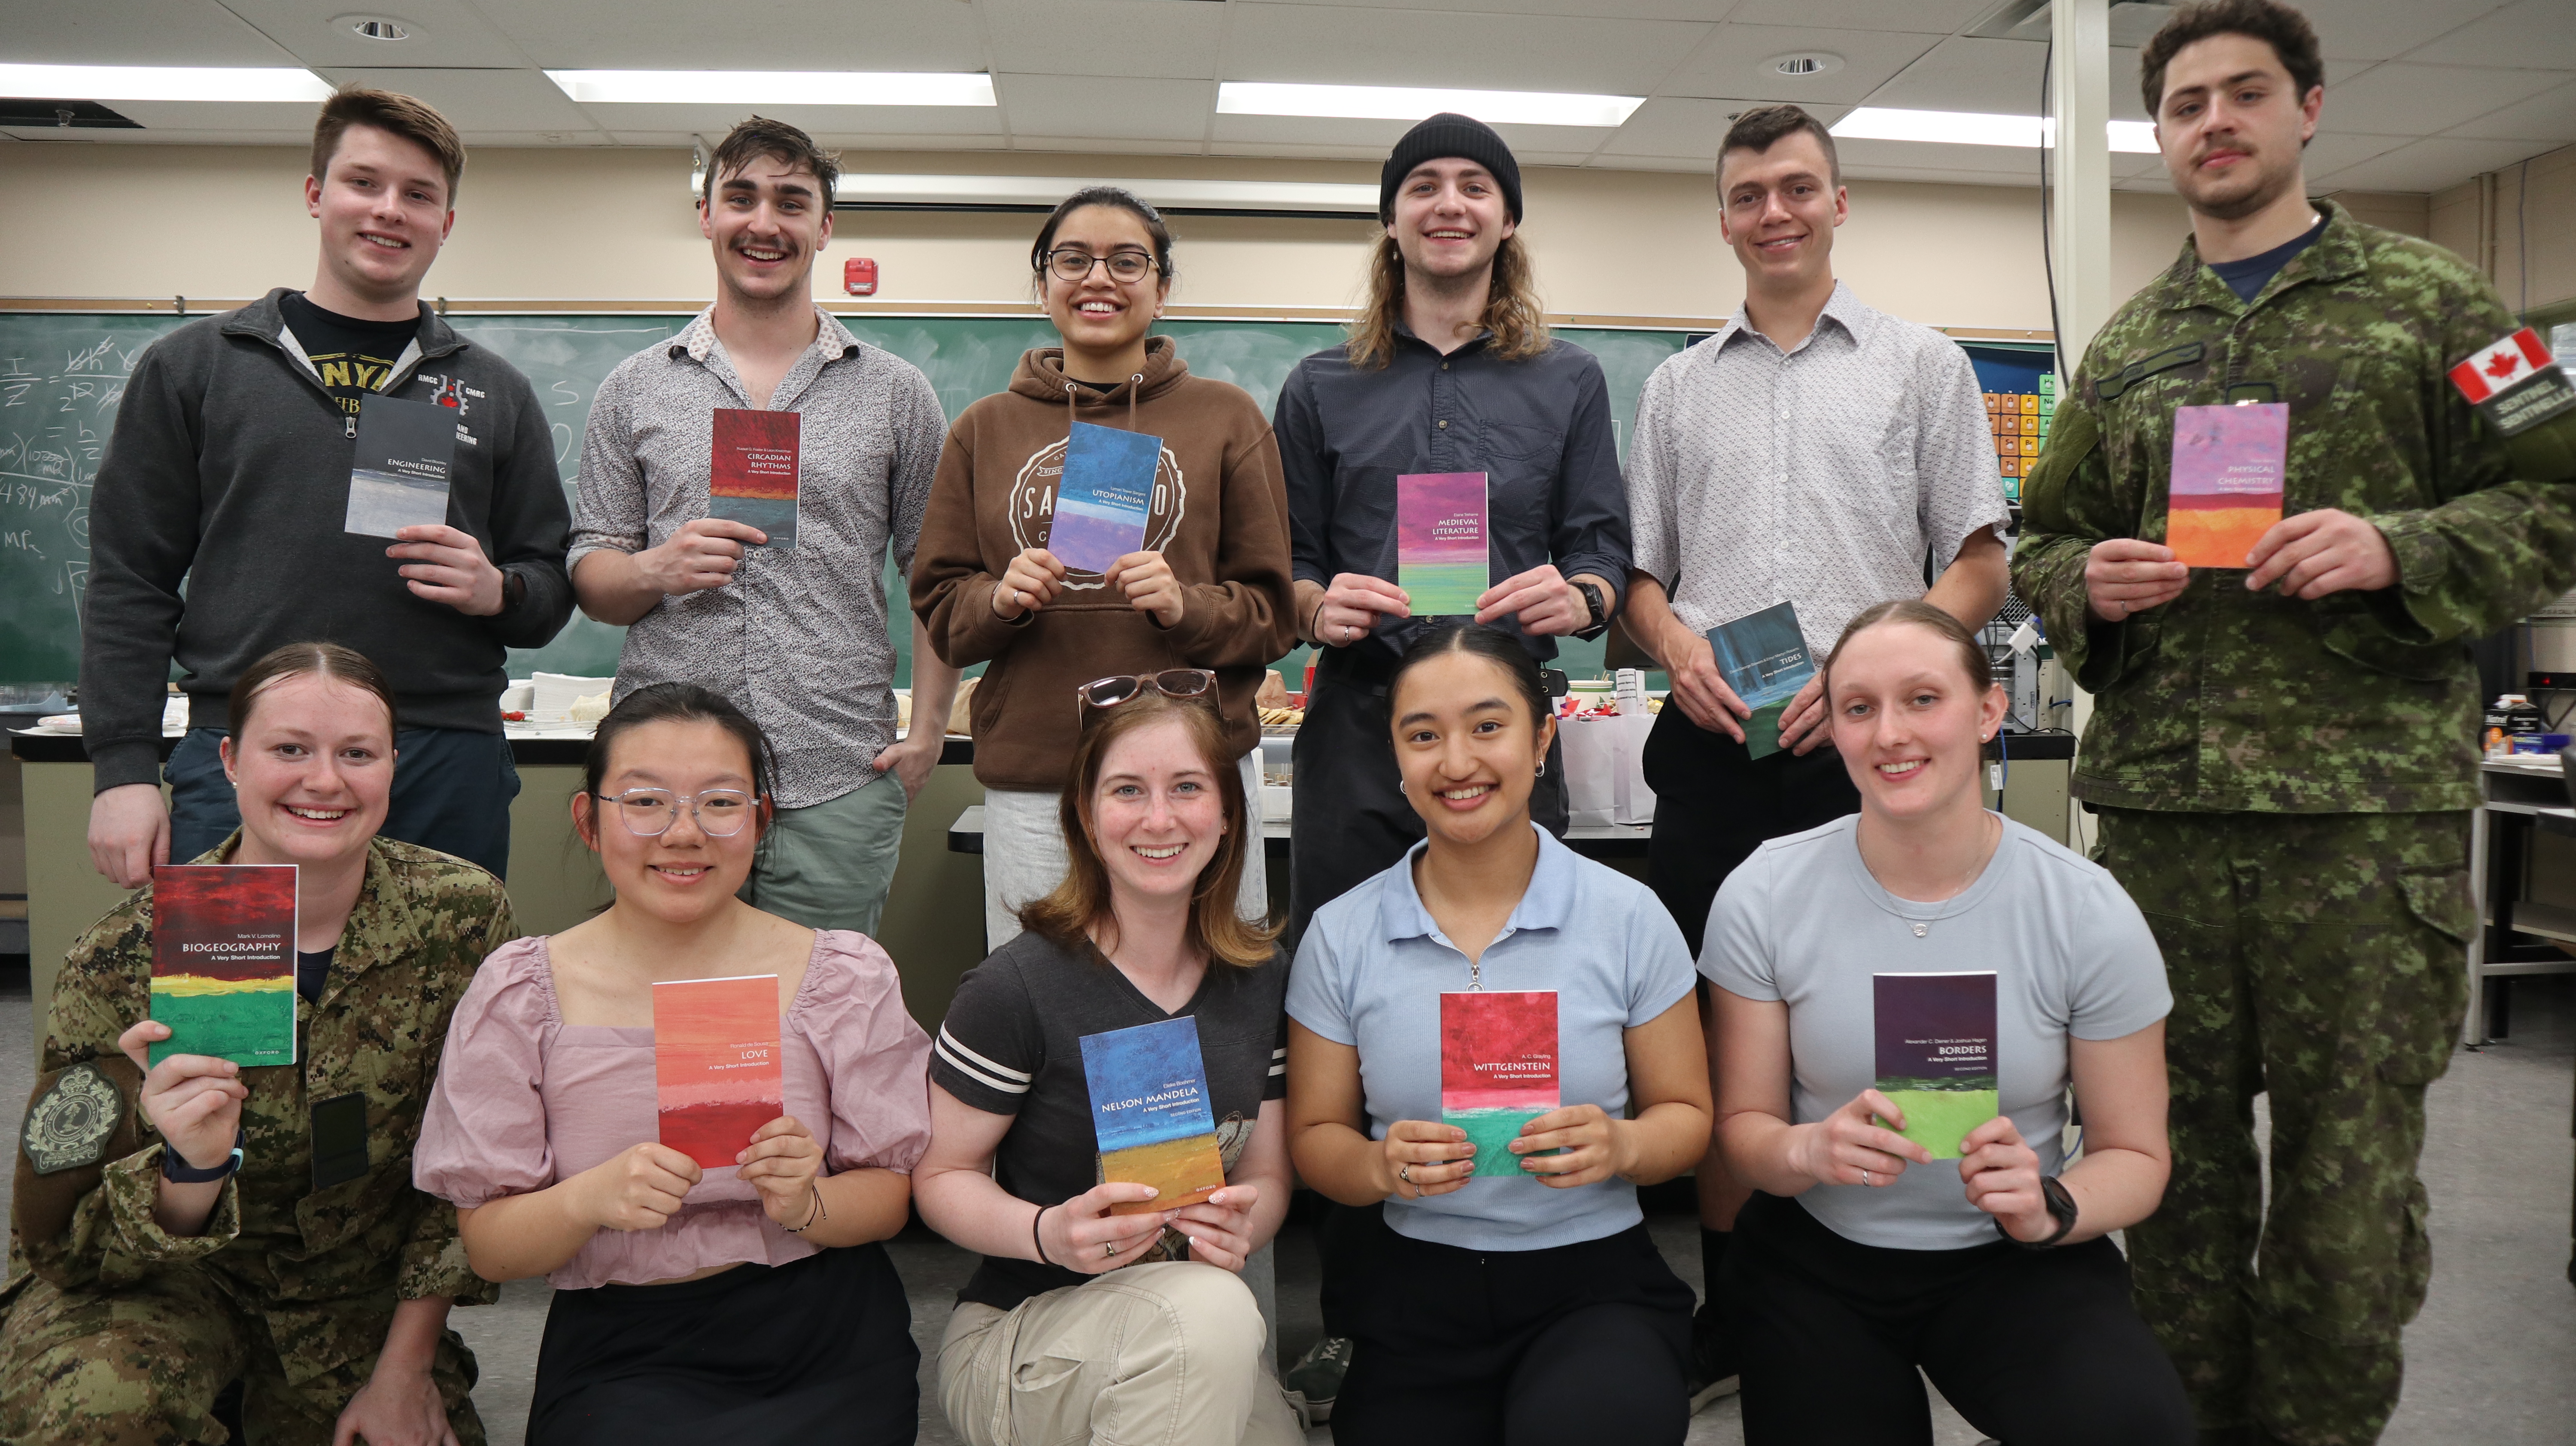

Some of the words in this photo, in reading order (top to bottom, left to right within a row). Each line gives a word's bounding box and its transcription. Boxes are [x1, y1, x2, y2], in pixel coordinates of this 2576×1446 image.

[418, 374, 438, 384] RMCC
[466, 387, 485, 398] CMRC
[457, 423, 468, 434] AND
[388, 459, 445, 473] ENGINEERING
[1093, 489, 1144, 505] UTOPIANISM
[1779, 653, 1801, 665] TIDES
[1783, 661, 1804, 671] Introduction
[183, 943, 281, 952] BIOGEOGRAPHY
[742, 1050, 768, 1059] LOVE
[1939, 1045, 1987, 1055] BORDERS
[1474, 1062, 1550, 1071] WITTGENSTEIN
[1102, 1098, 1142, 1112] NELSON
[1146, 1087, 1198, 1104] MANDELA
[1172, 1098, 1200, 1106] Introduction
